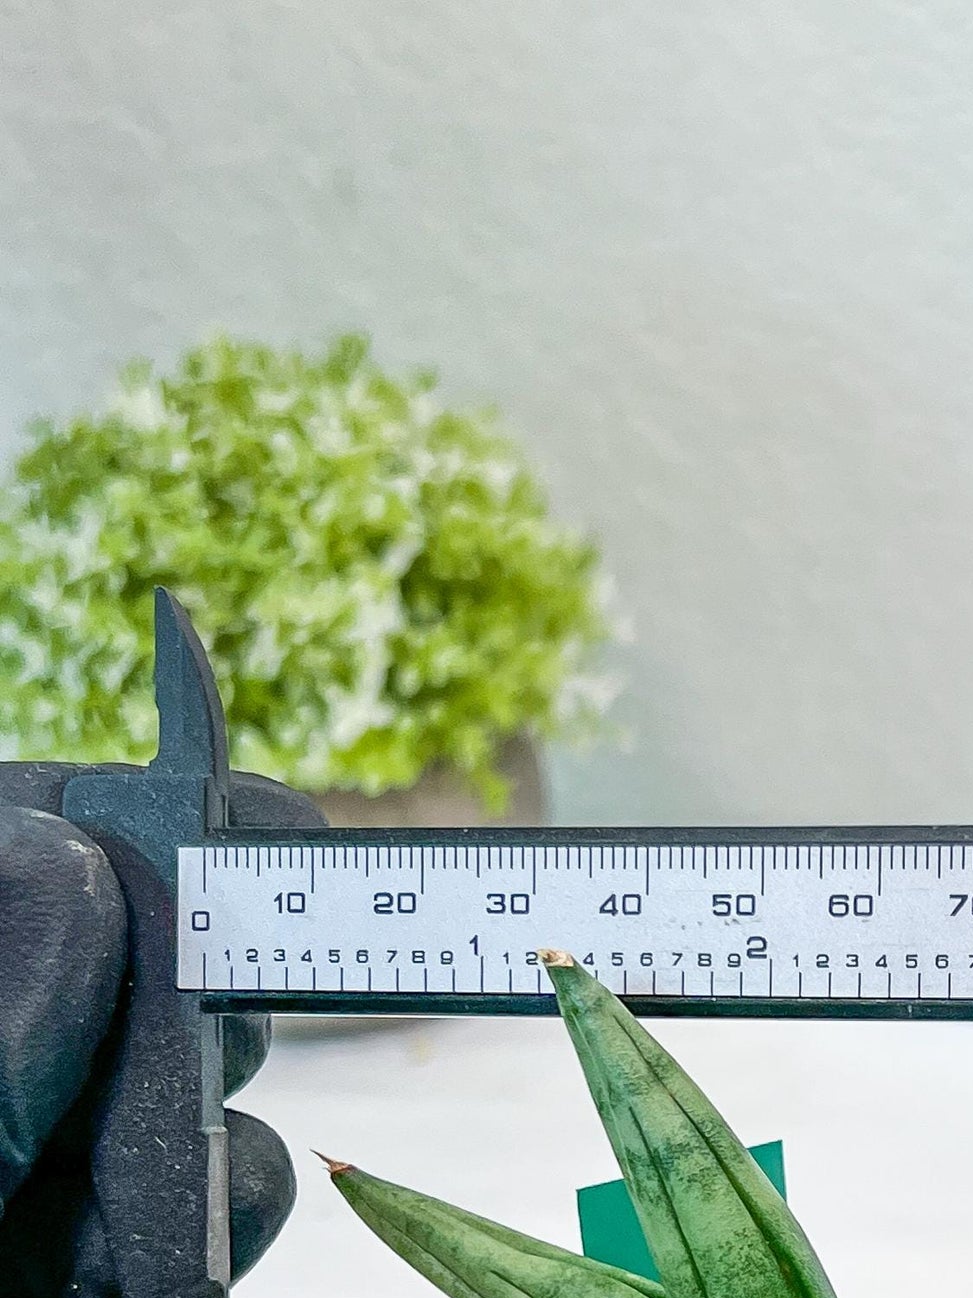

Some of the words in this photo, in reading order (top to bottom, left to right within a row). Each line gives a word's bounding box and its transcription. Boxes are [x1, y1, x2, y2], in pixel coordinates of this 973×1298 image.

[191, 910, 211, 932] 0
[273, 891, 306, 914] 10
[373, 891, 417, 915] 20
[485, 893, 530, 915] 30
[598, 893, 642, 917] 40
[712, 893, 756, 917] 50
[828, 894, 874, 918] 60
[224, 949, 231, 962] 1
[245, 948, 259, 963] 2
[273, 948, 286, 962] 3
[300, 949, 313, 963] 4
[328, 949, 341, 964] 5
[355, 949, 369, 964] 6
[386, 949, 398, 964] 7
[411, 950, 426, 964] 8
[440, 950, 454, 965] 9
[469, 934, 479, 957] 1
[502, 951, 509, 965] 1
[525, 951, 539, 966] 2
[582, 952, 595, 966] 4
[611, 951, 624, 967] 5
[639, 952, 653, 967] 6
[671, 951, 684, 967] 7
[697, 952, 712, 967] 8
[727, 952, 742, 968] 9
[746, 935, 768, 960] 2
[792, 954, 799, 968] 1
[815, 953, 830, 969] 2
[845, 953, 859, 968] 3
[874, 954, 888, 969] 4
[905, 953, 919, 969] 5
[935, 954, 949, 970] 6
